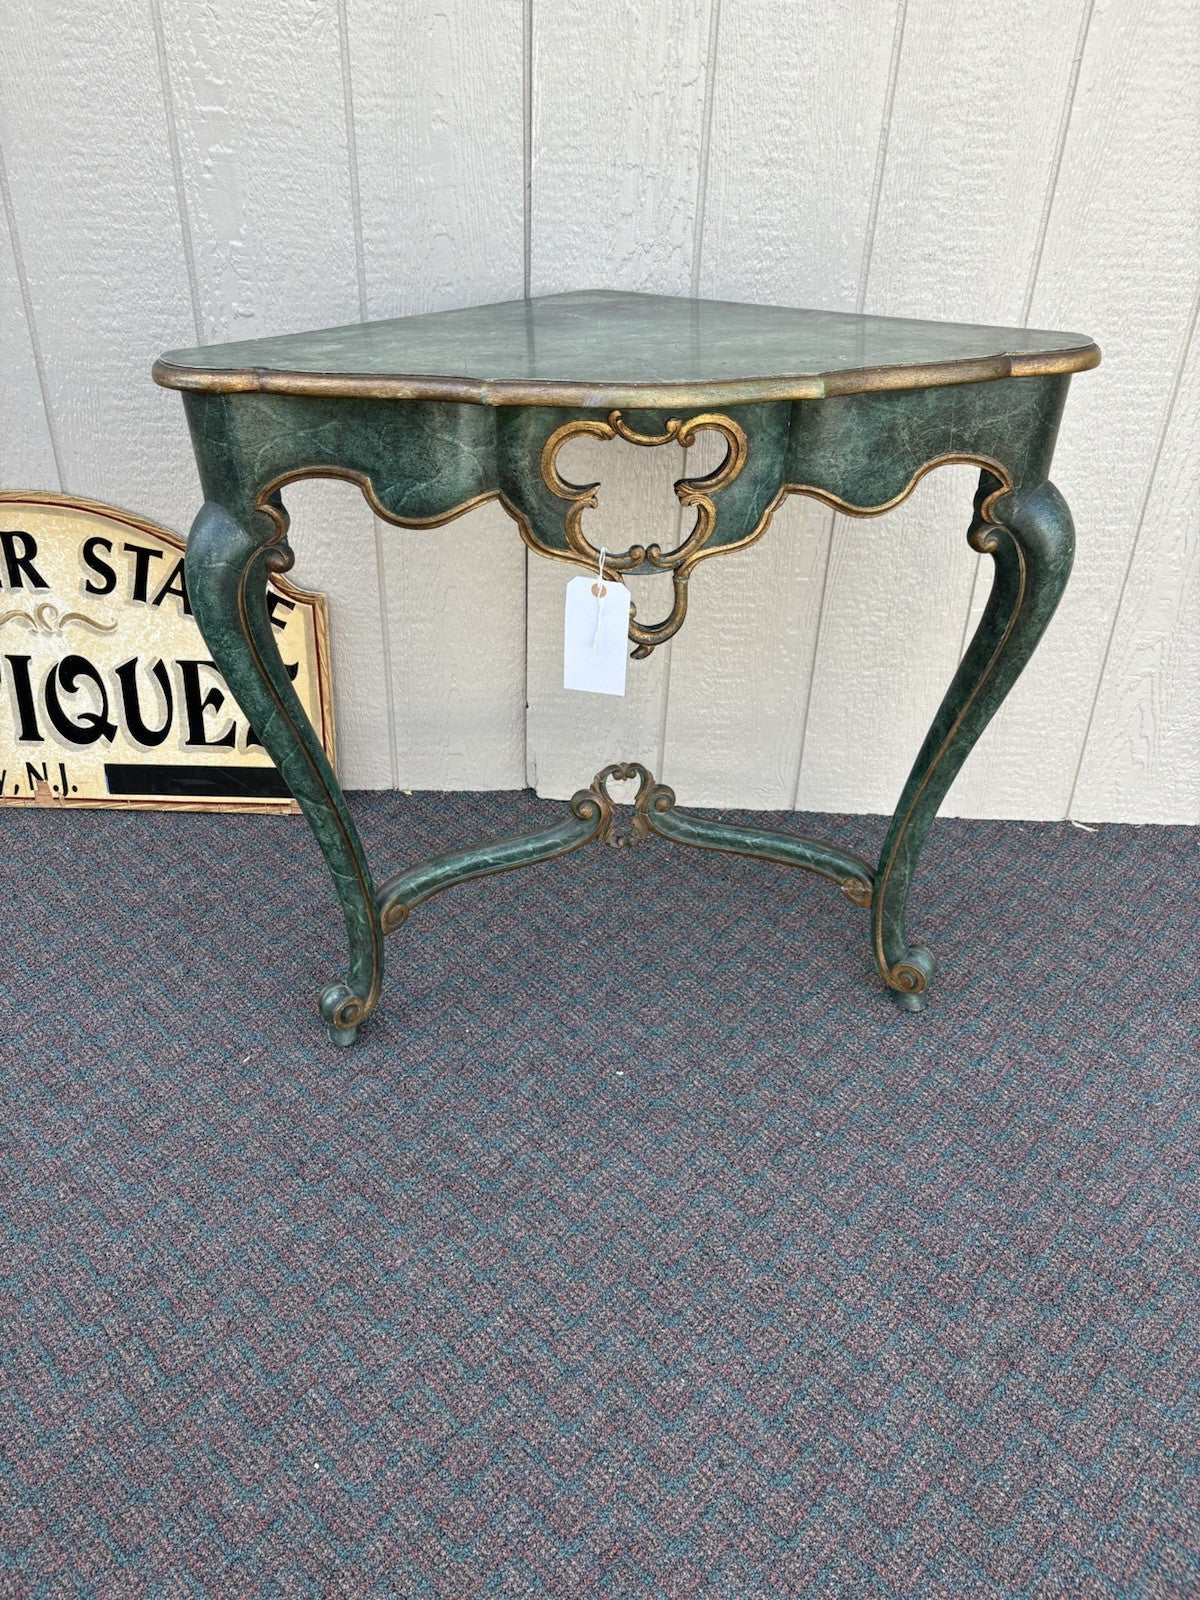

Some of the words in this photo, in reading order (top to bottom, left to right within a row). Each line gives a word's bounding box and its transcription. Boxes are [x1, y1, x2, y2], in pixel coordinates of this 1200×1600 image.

[0, 531, 50, 588] R
[83, 537, 296, 632] STAE
[0, 654, 299, 748] IQUE
